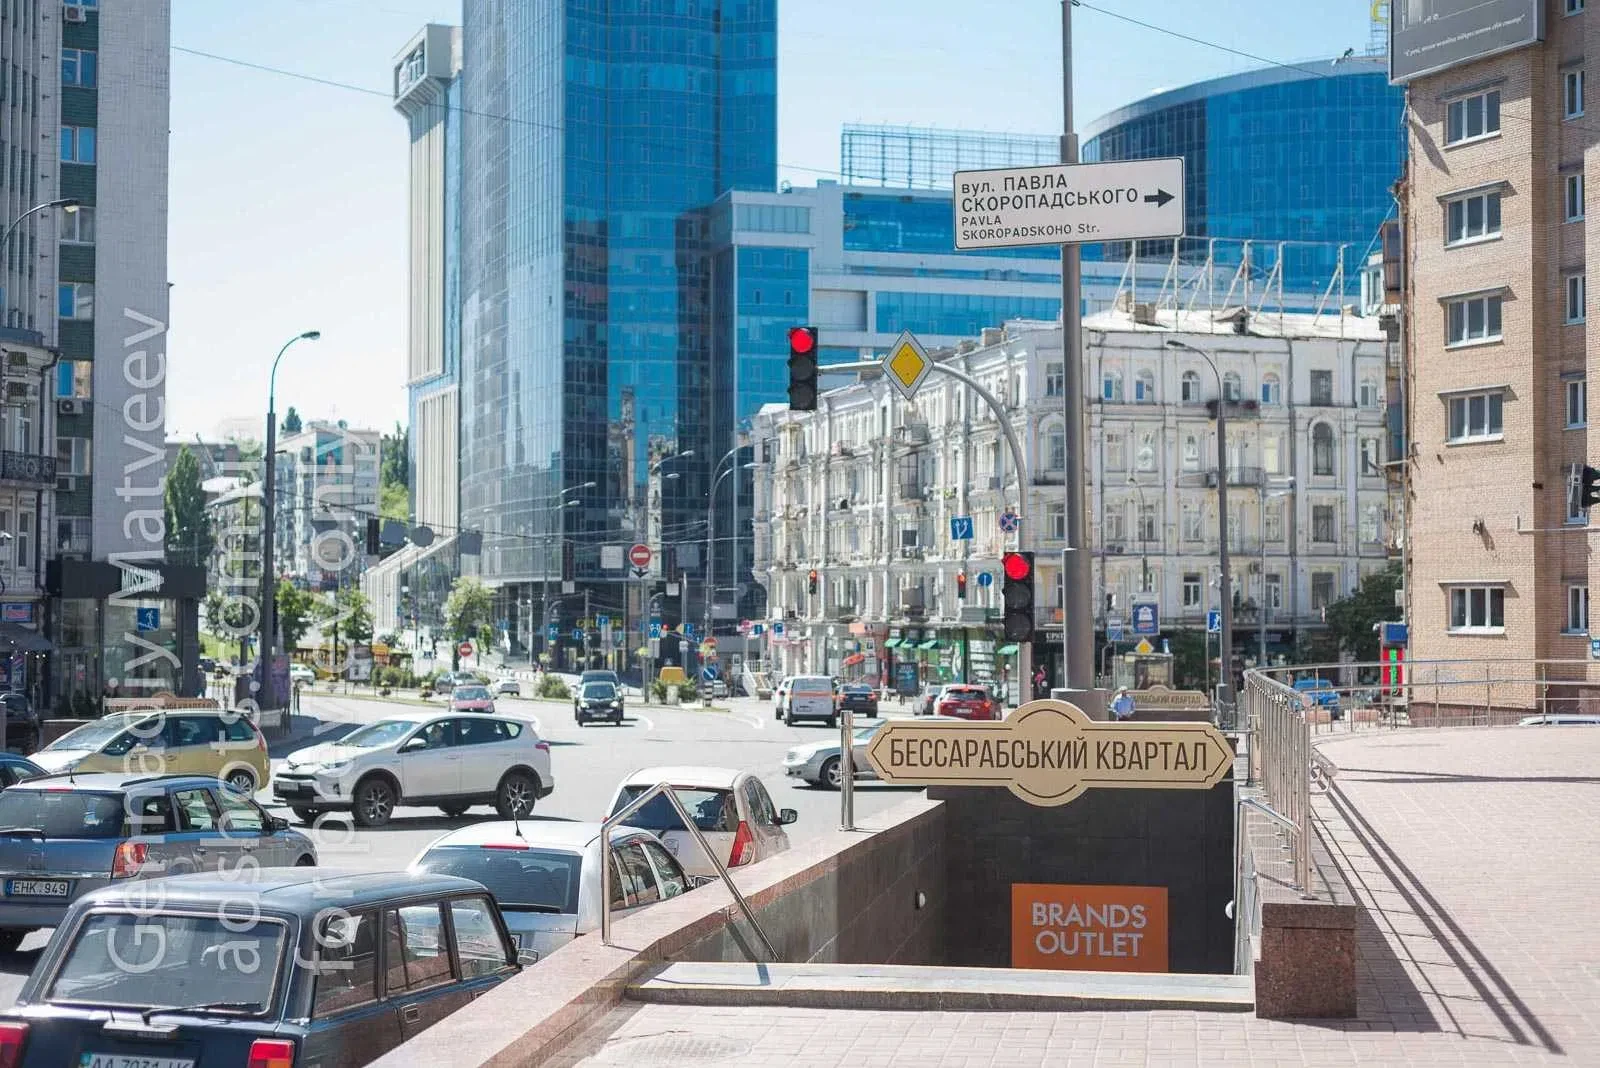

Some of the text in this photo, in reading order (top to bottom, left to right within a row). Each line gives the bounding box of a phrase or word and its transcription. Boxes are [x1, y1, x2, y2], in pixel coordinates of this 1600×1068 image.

[961, 174, 1068, 197] вул. ПАВЛА
[961, 188, 1138, 213] СКОРОПАДСЬКОГО
[961, 215, 1002, 226] PAVLA
[962, 223, 1100, 240] SKOROPADSKOHO Str.
[890, 737, 1208, 771] БЕССАРАБСЬКИЙ КВАРТАЛ
[14, 882, 66, 894] EHK 949
[1032, 903, 1147, 928] BRANDS
[1036, 930, 1143, 957] OUTLET
